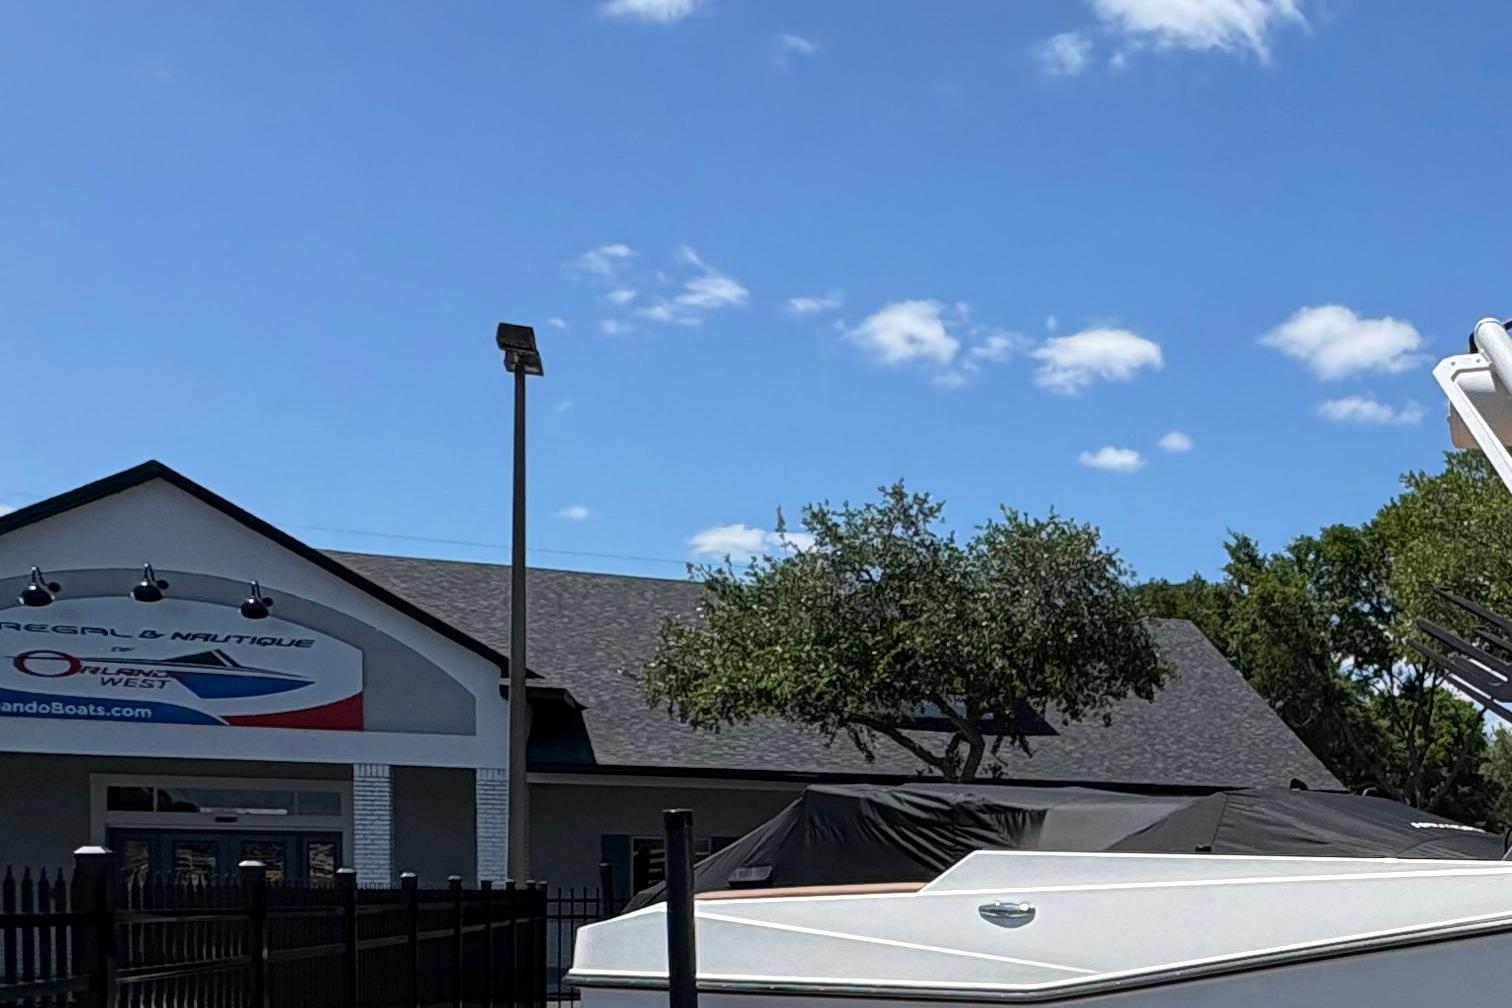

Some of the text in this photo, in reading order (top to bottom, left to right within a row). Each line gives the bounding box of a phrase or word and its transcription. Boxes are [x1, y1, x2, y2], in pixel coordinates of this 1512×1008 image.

[0, 621, 316, 648] REGAL & NAUTIQUE
[101, 677, 171, 689] WEST
